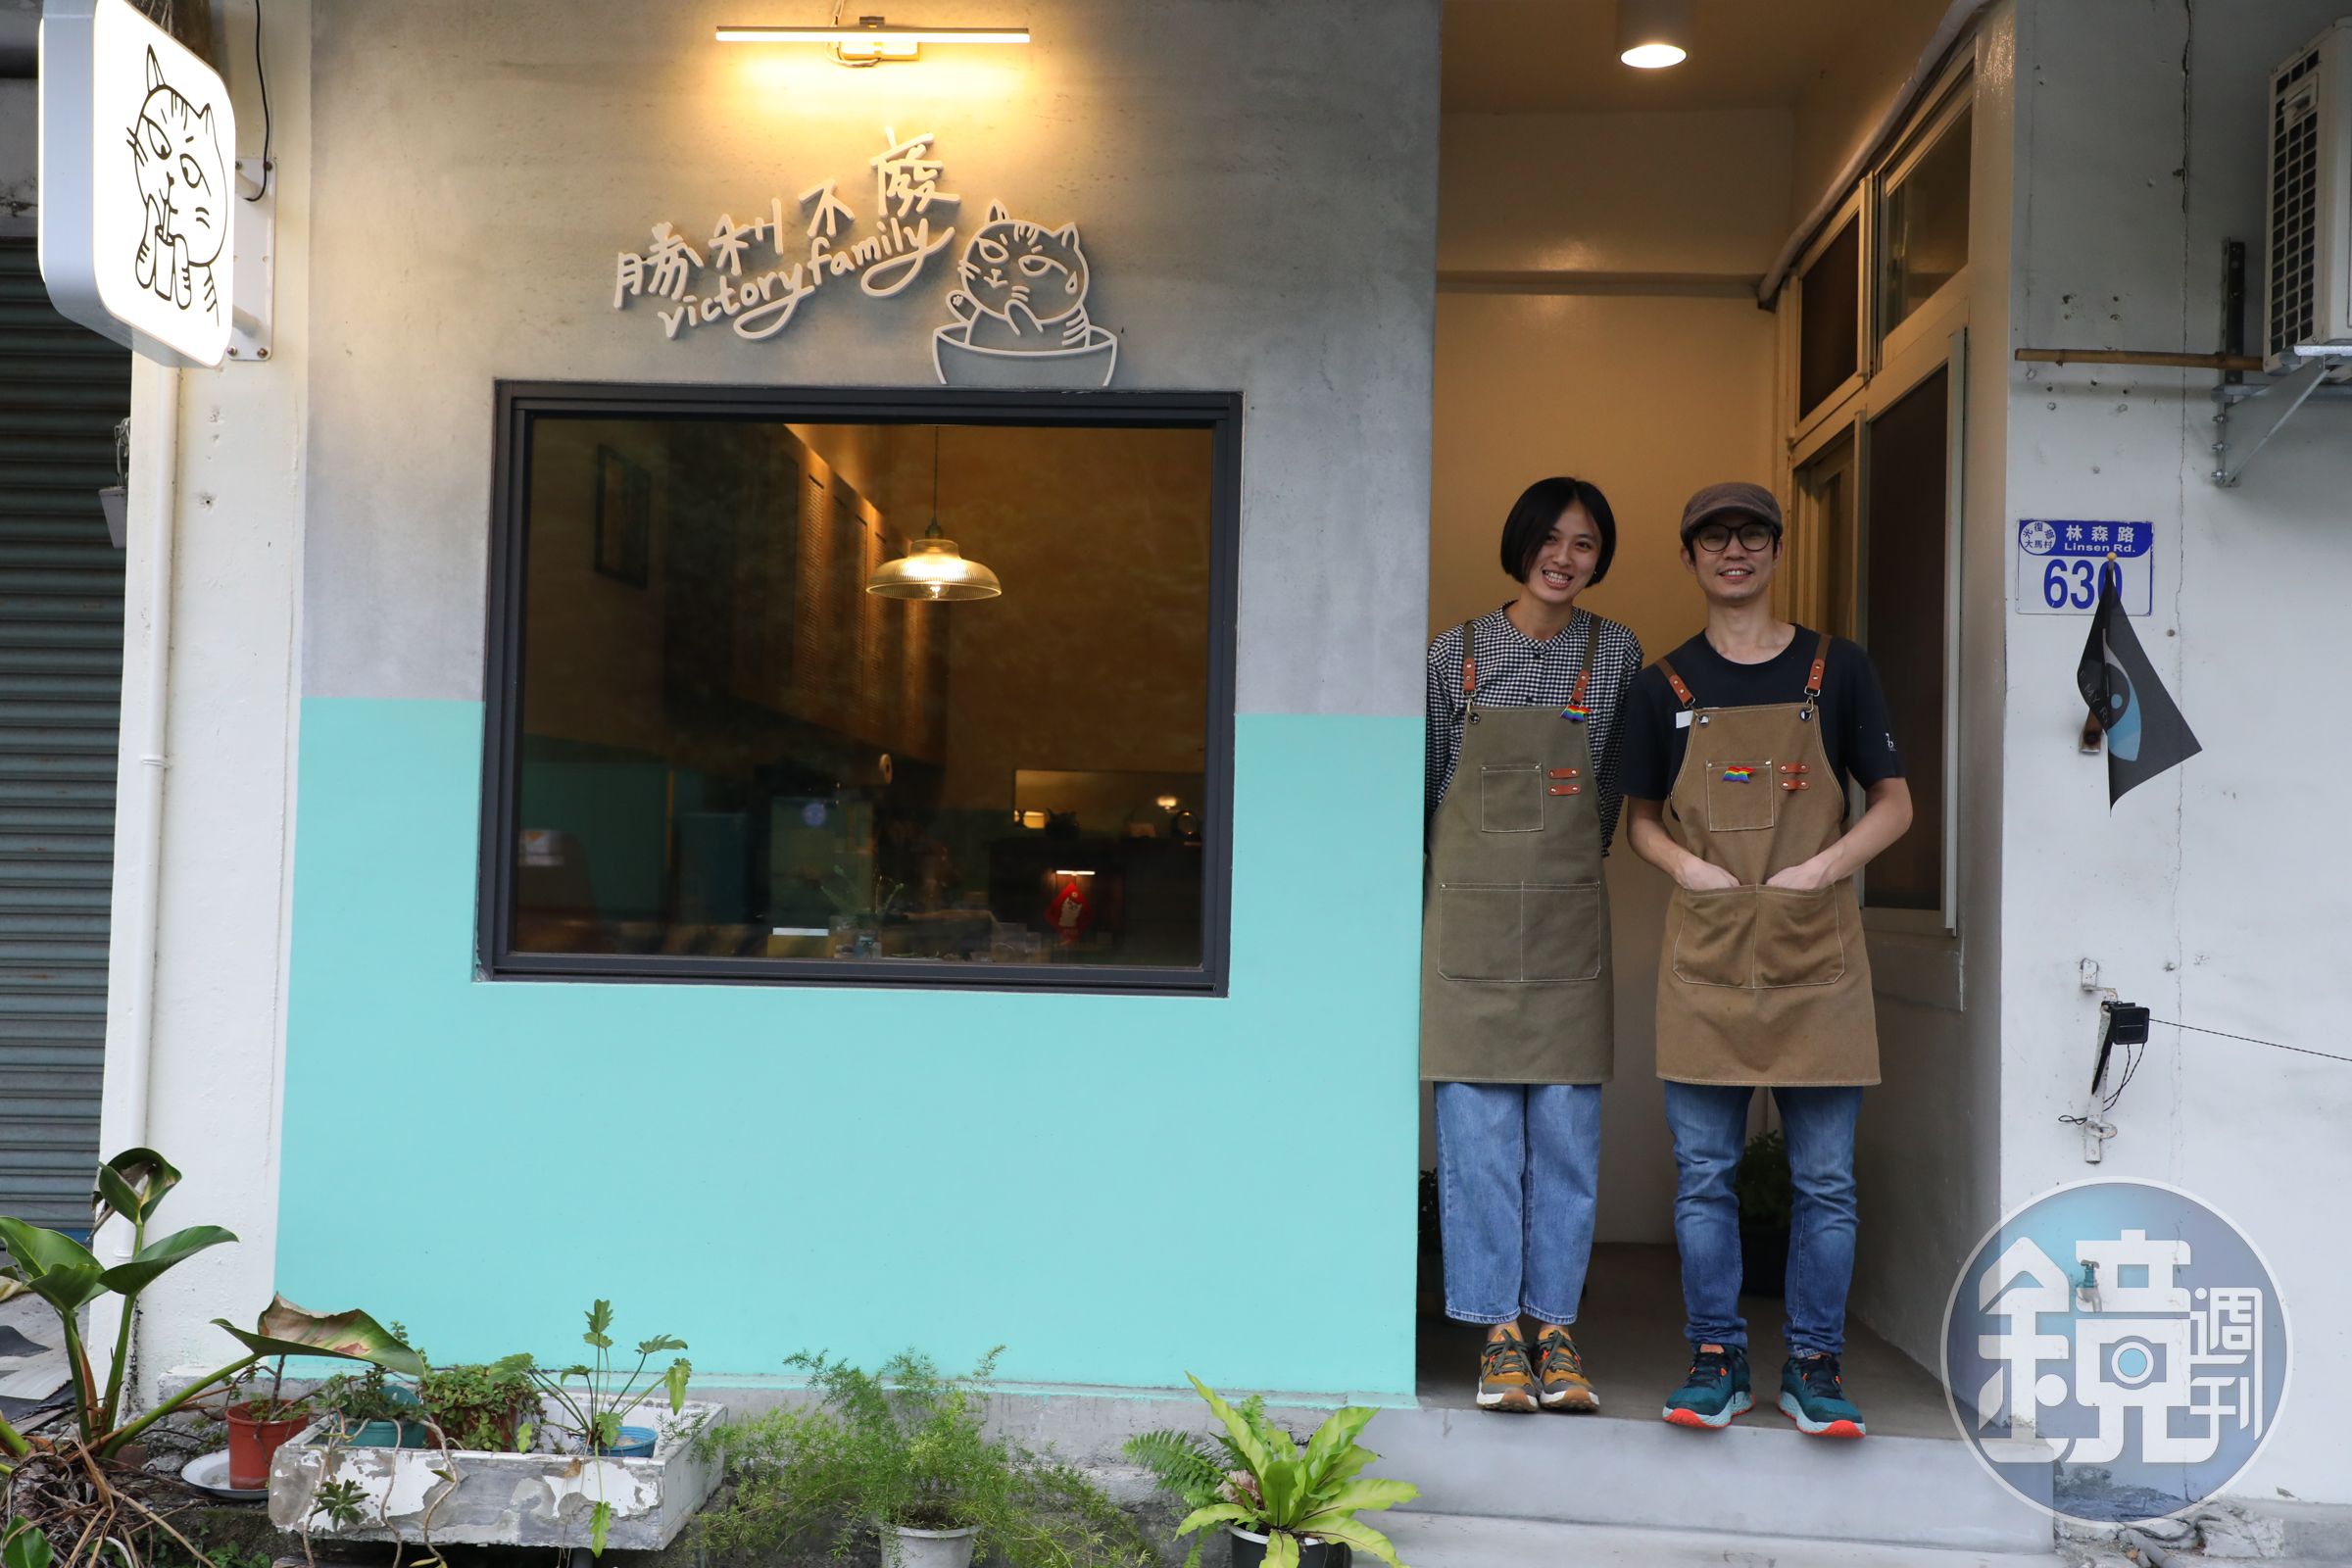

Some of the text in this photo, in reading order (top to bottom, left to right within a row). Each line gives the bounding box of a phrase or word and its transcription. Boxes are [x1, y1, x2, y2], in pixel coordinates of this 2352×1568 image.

[808, 218, 956, 298] family
[2066, 525, 2134, 542] 林森路
[2025, 540, 2052, 549] 大馬村
[2064, 542, 2135, 553] Linsen Rd.
[2043, 559, 2123, 610] 630
